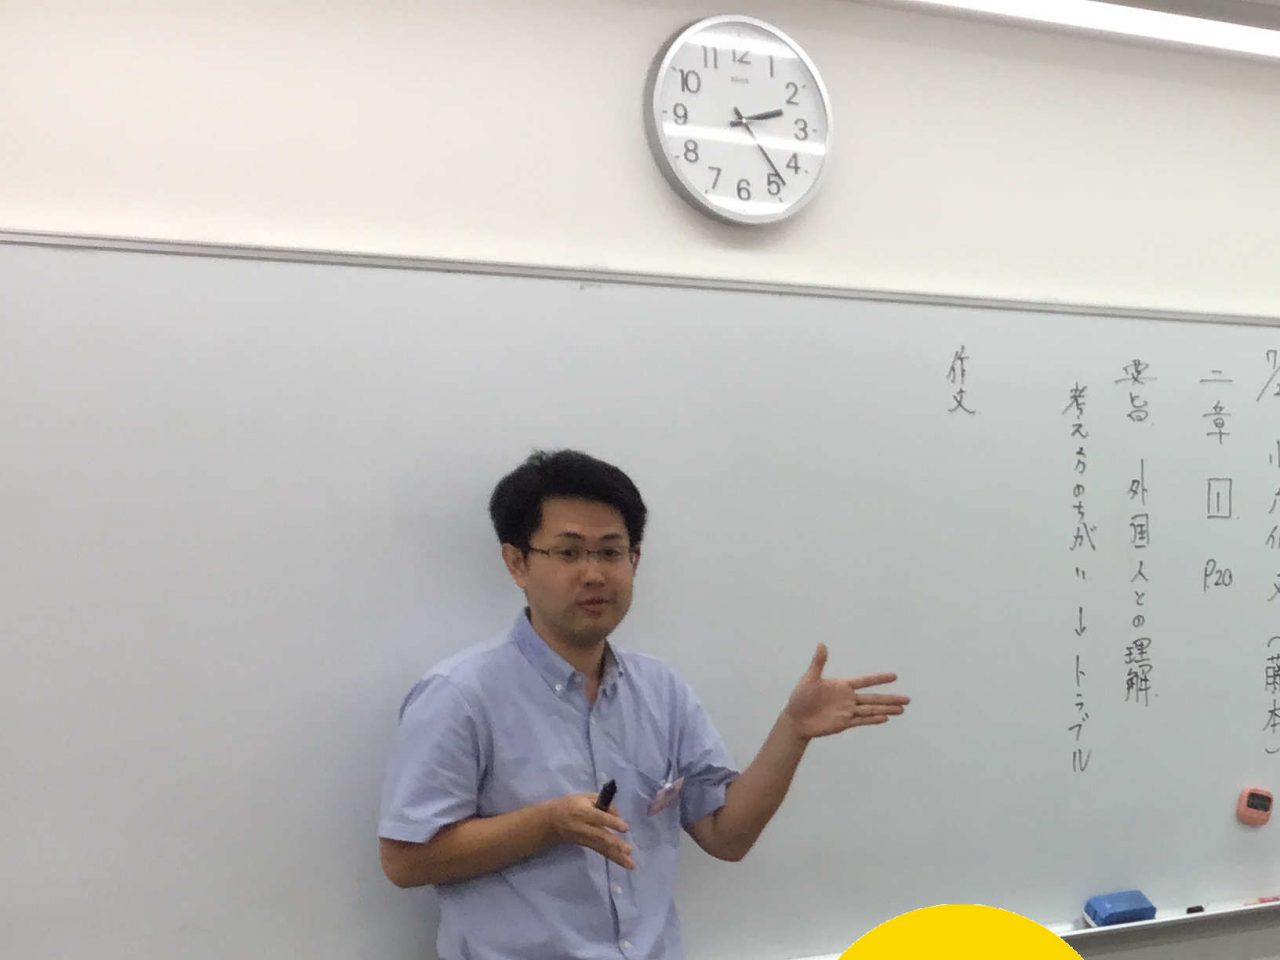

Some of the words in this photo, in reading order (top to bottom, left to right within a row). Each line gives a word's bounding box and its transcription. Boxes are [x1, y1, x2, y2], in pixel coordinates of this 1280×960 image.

[702, 45, 718, 69] 11
[768, 55, 774, 78] 1
[678, 68, 701, 94] 10
[785, 81, 800, 106] 2
[672, 102, 688, 126] 9
[794, 118, 808, 141] 3
[683, 139, 699, 163] 8
[786, 152, 801, 175] 4
[707, 166, 722, 190] 7
[736, 178, 751, 201] 6
[766, 173, 782, 196] 5
[946, 344, 976, 415] 作文
[1199, 369, 1233, 445] 二章
[1067, 654, 1092, 773] トラブル
